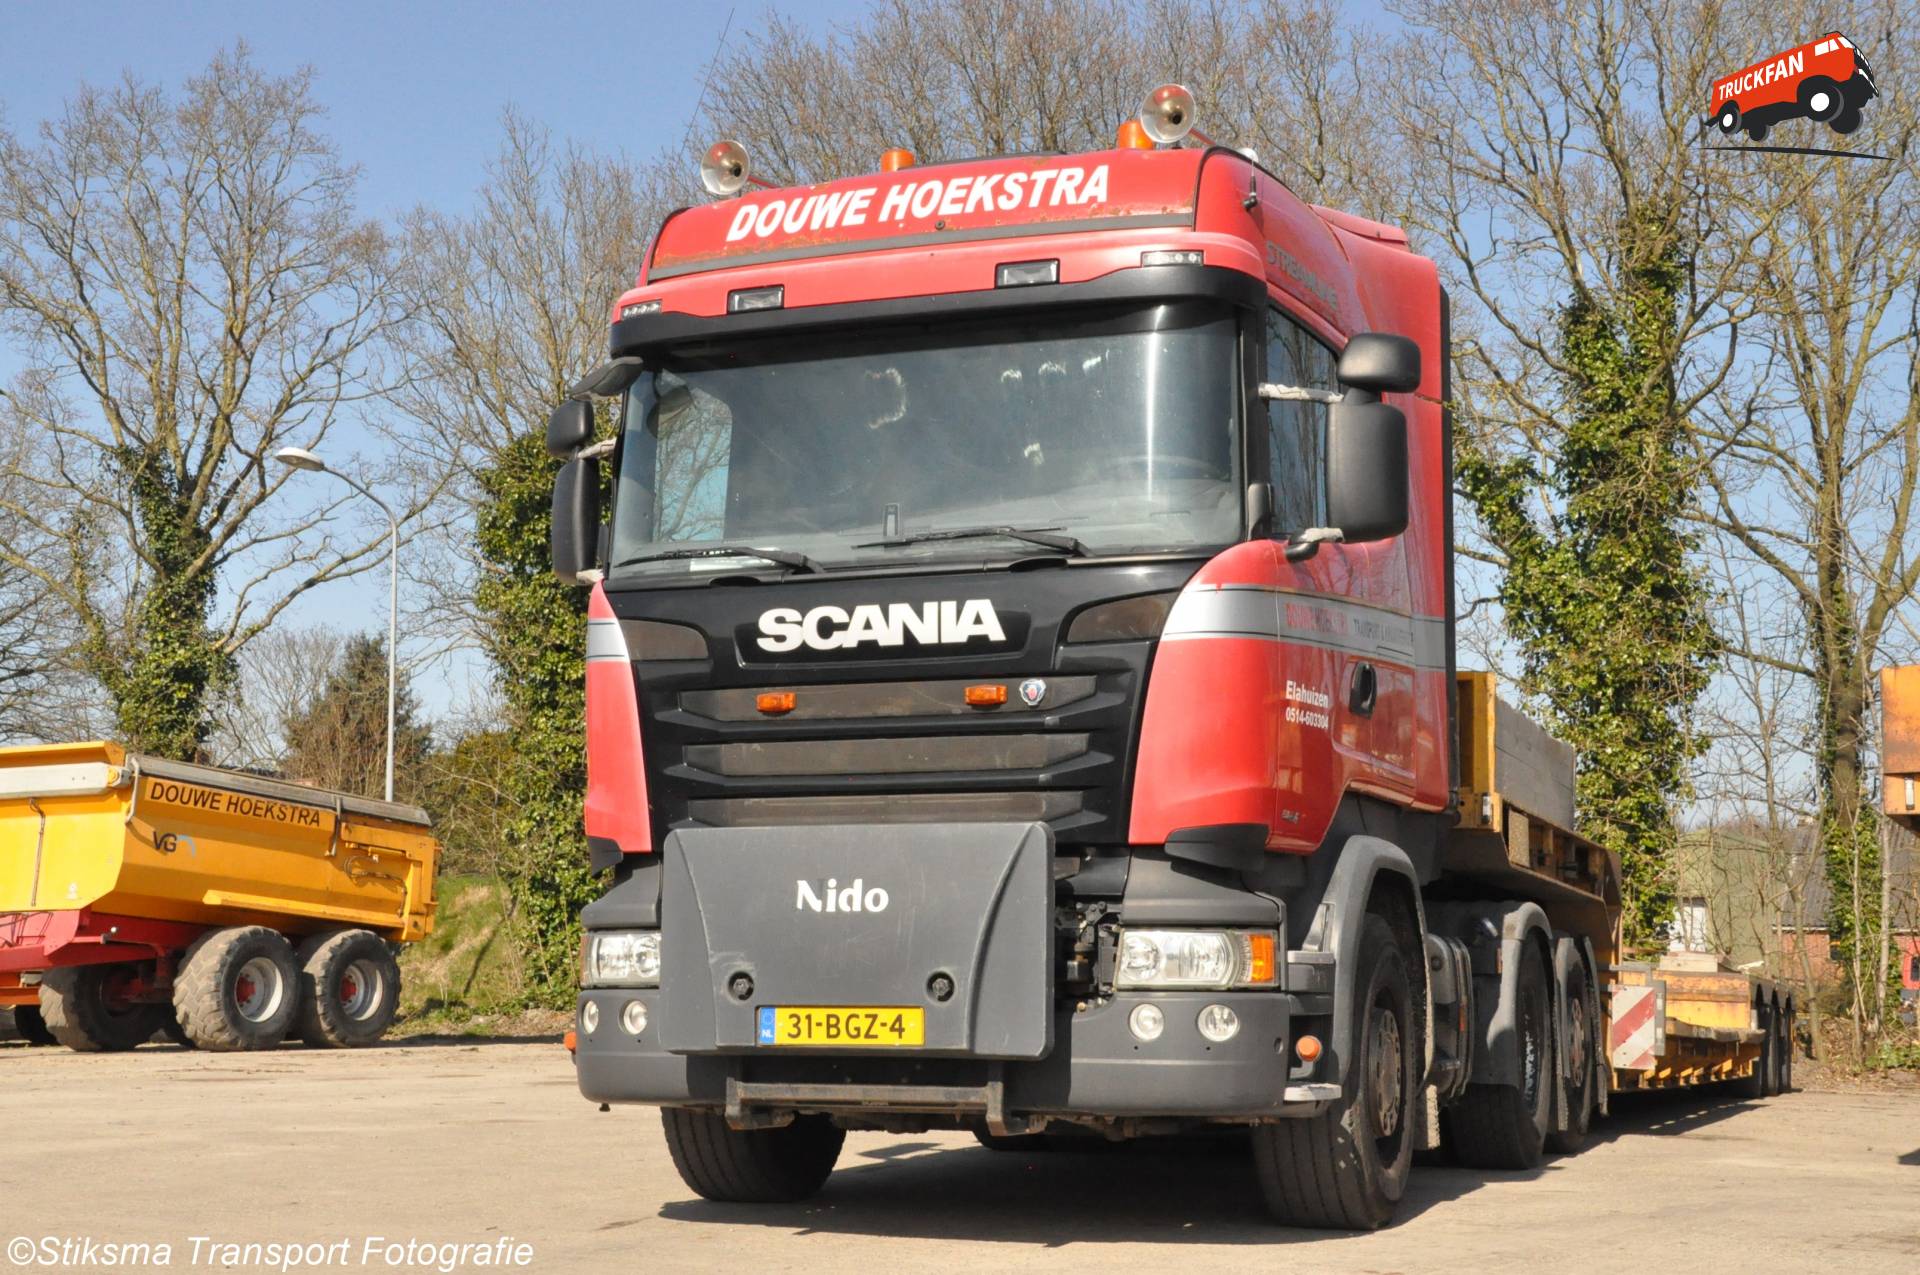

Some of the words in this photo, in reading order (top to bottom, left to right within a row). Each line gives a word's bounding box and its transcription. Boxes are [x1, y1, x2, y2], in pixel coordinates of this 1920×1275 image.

[726, 186, 876, 242] DOUWE
[878, 165, 1109, 222] HOEKSTRA
[757, 599, 1006, 652] SCANIA
[1285, 680, 1329, 708] Elahuizen
[150, 782, 223, 811] DOUWE
[226, 795, 321, 827] HOEKSTRA
[153, 831, 177, 853] VG
[796, 878, 889, 913] Nido
[761, 1029, 774, 1038] NL
[787, 1013, 906, 1040] 31-BGZ-4
